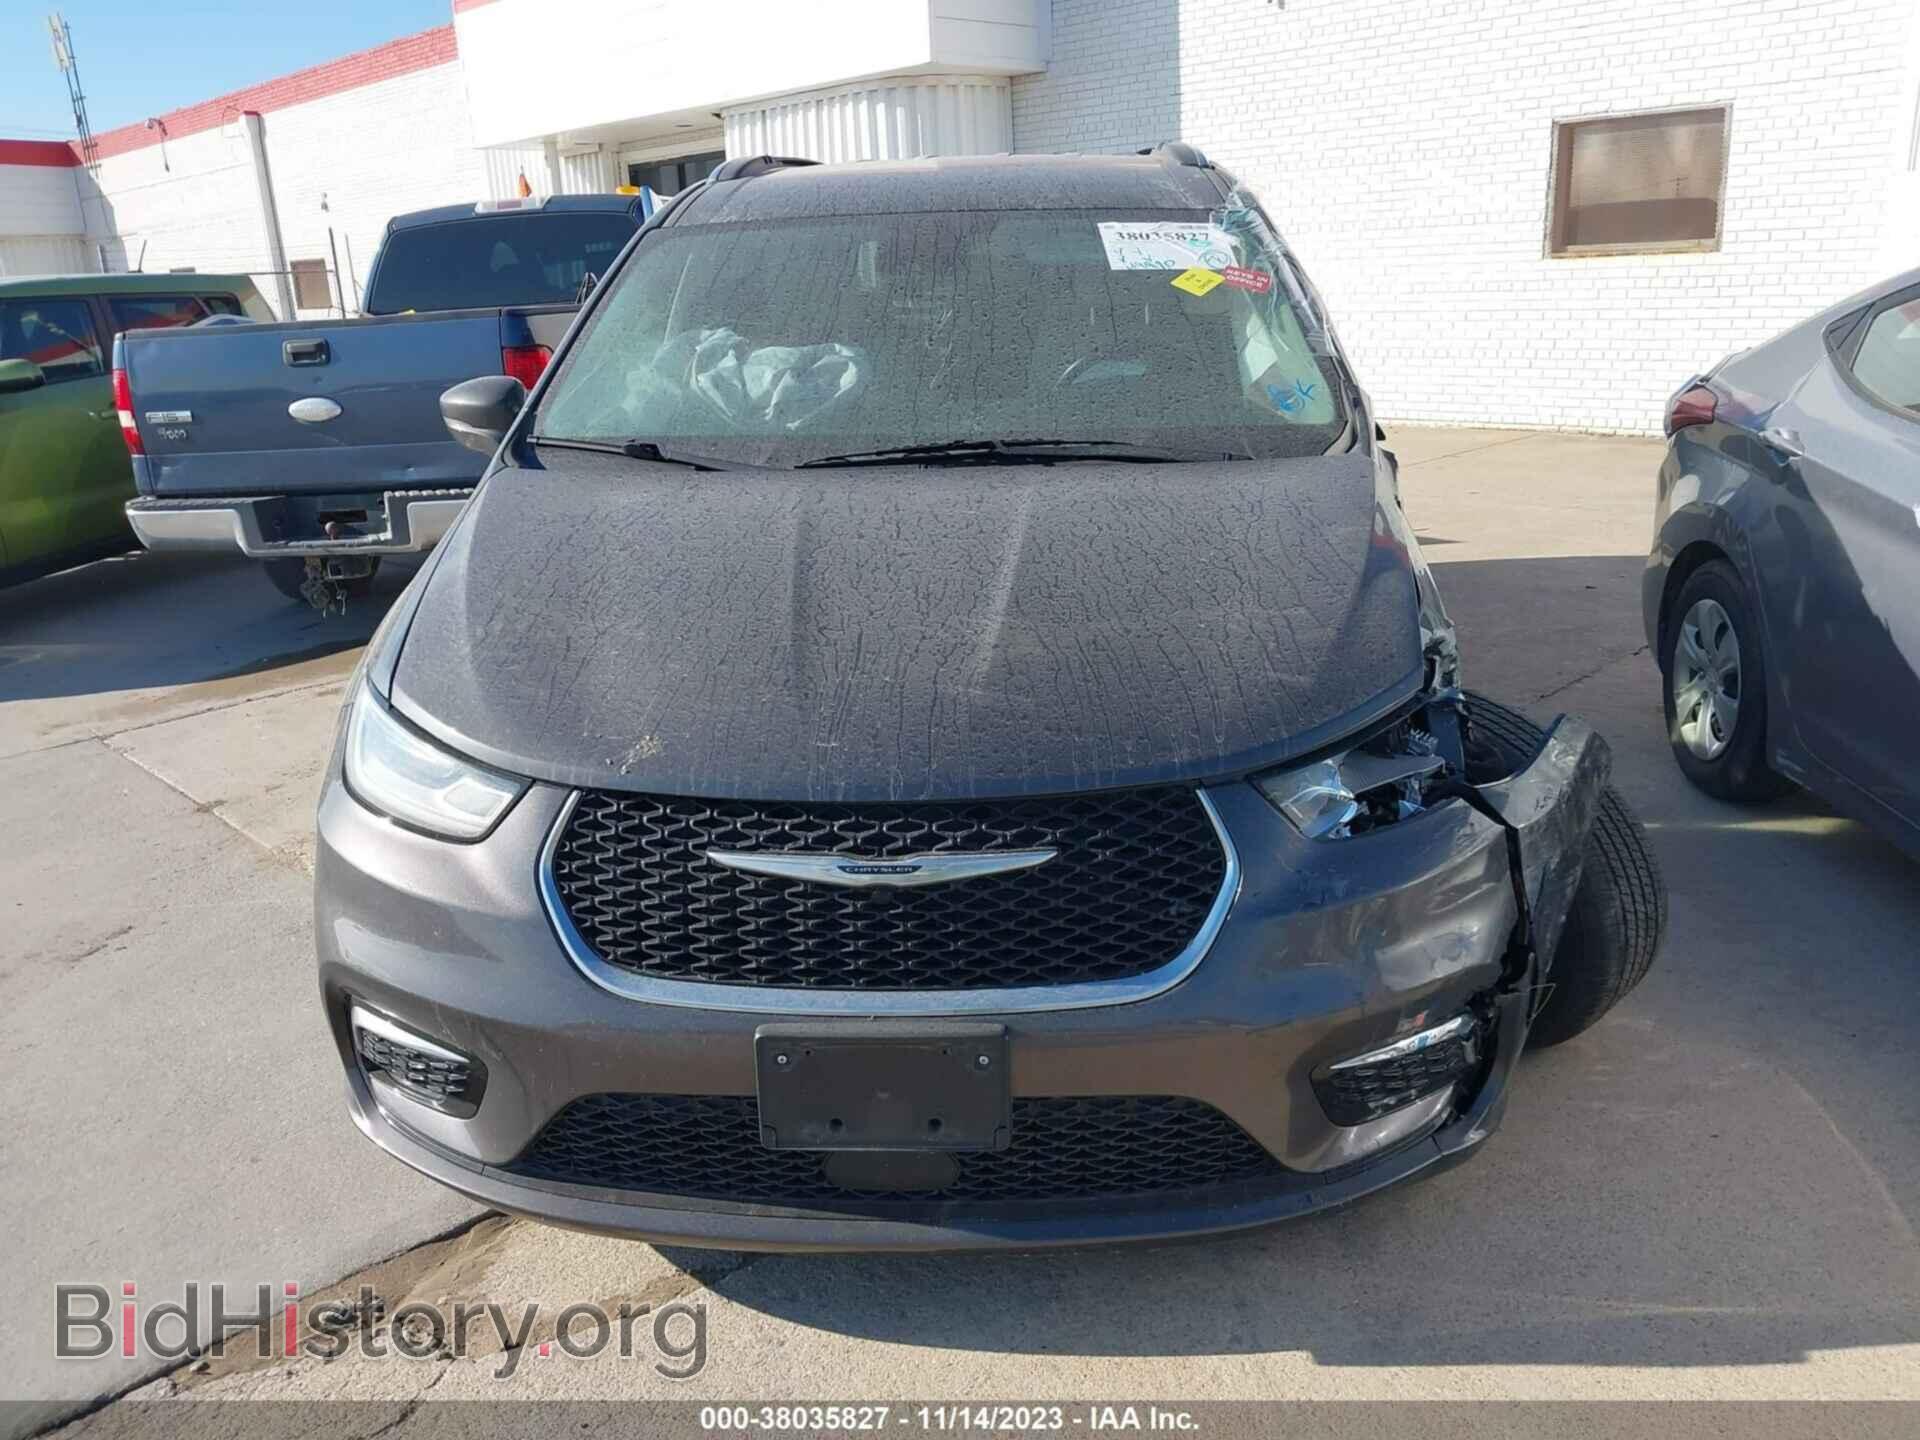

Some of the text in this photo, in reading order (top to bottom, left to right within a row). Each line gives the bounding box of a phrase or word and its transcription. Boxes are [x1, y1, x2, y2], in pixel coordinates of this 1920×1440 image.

[1114, 231, 1210, 242] 38035827
[1225, 269, 1254, 280] KEYS
[845, 865, 913, 873] CHRYSLER
